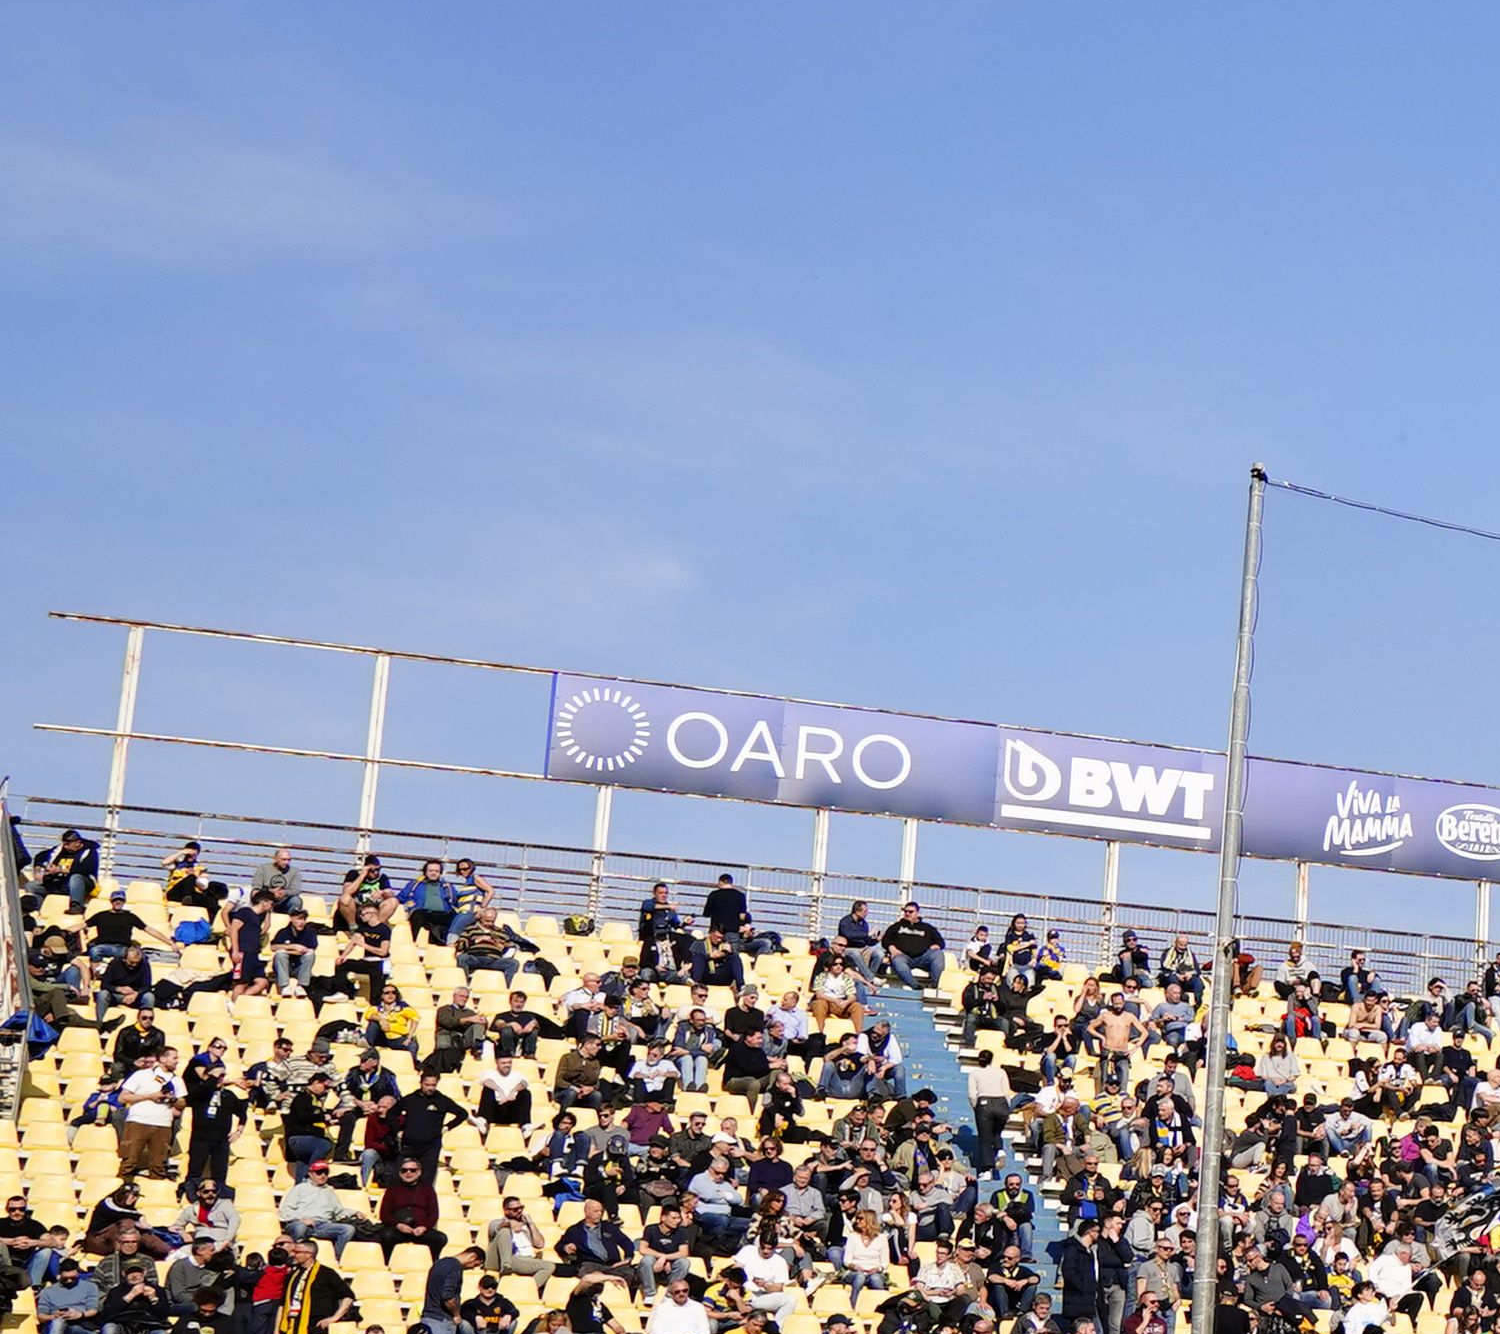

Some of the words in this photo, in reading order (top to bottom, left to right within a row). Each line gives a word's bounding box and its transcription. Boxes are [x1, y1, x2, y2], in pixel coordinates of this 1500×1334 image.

[667, 712, 911, 790] OARO
[1069, 766, 1214, 820] BWT
[1323, 813, 1414, 852] MAMMA
